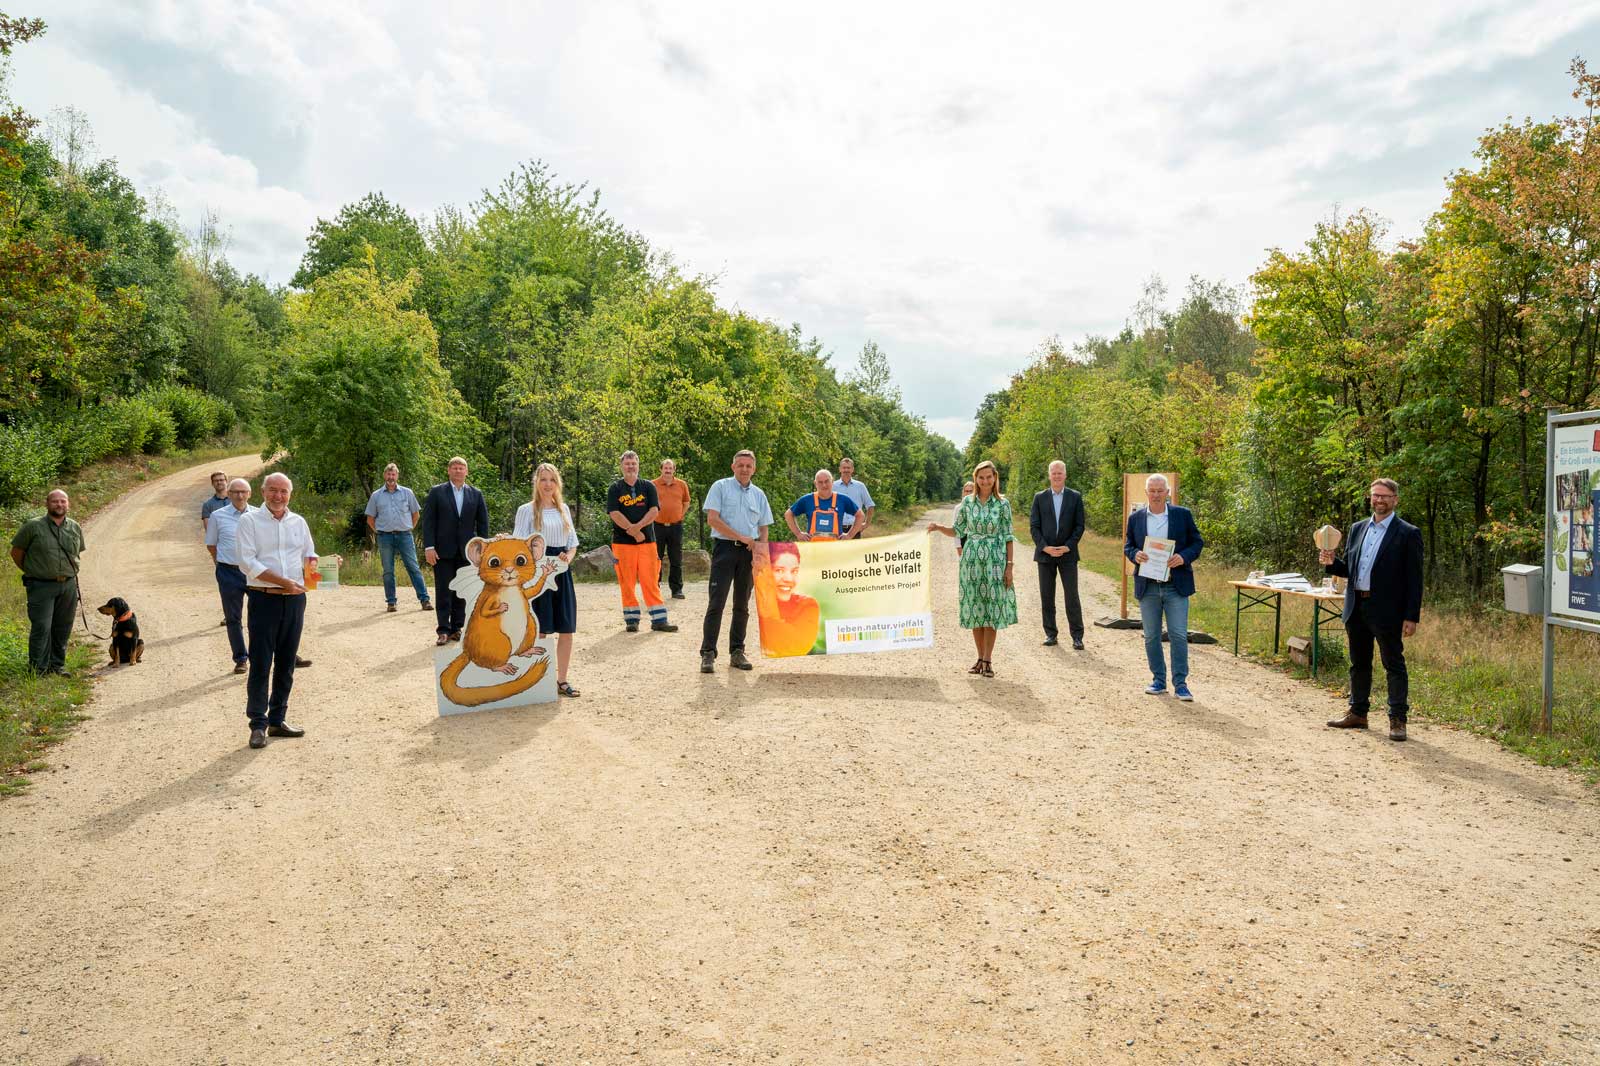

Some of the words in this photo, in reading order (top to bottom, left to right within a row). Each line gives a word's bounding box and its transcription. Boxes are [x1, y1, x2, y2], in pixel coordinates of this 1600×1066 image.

[865, 550, 921, 564] UN-Dekade
[821, 568, 882, 580] Biologische
[885, 563, 921, 575] Vielfalt
[835, 583, 895, 594] Ausgezeichnetes
[897, 581, 921, 590] Projekt
[1571, 595, 1586, 605] RWE
[837, 620, 924, 632] leben.natur.vielfalt
